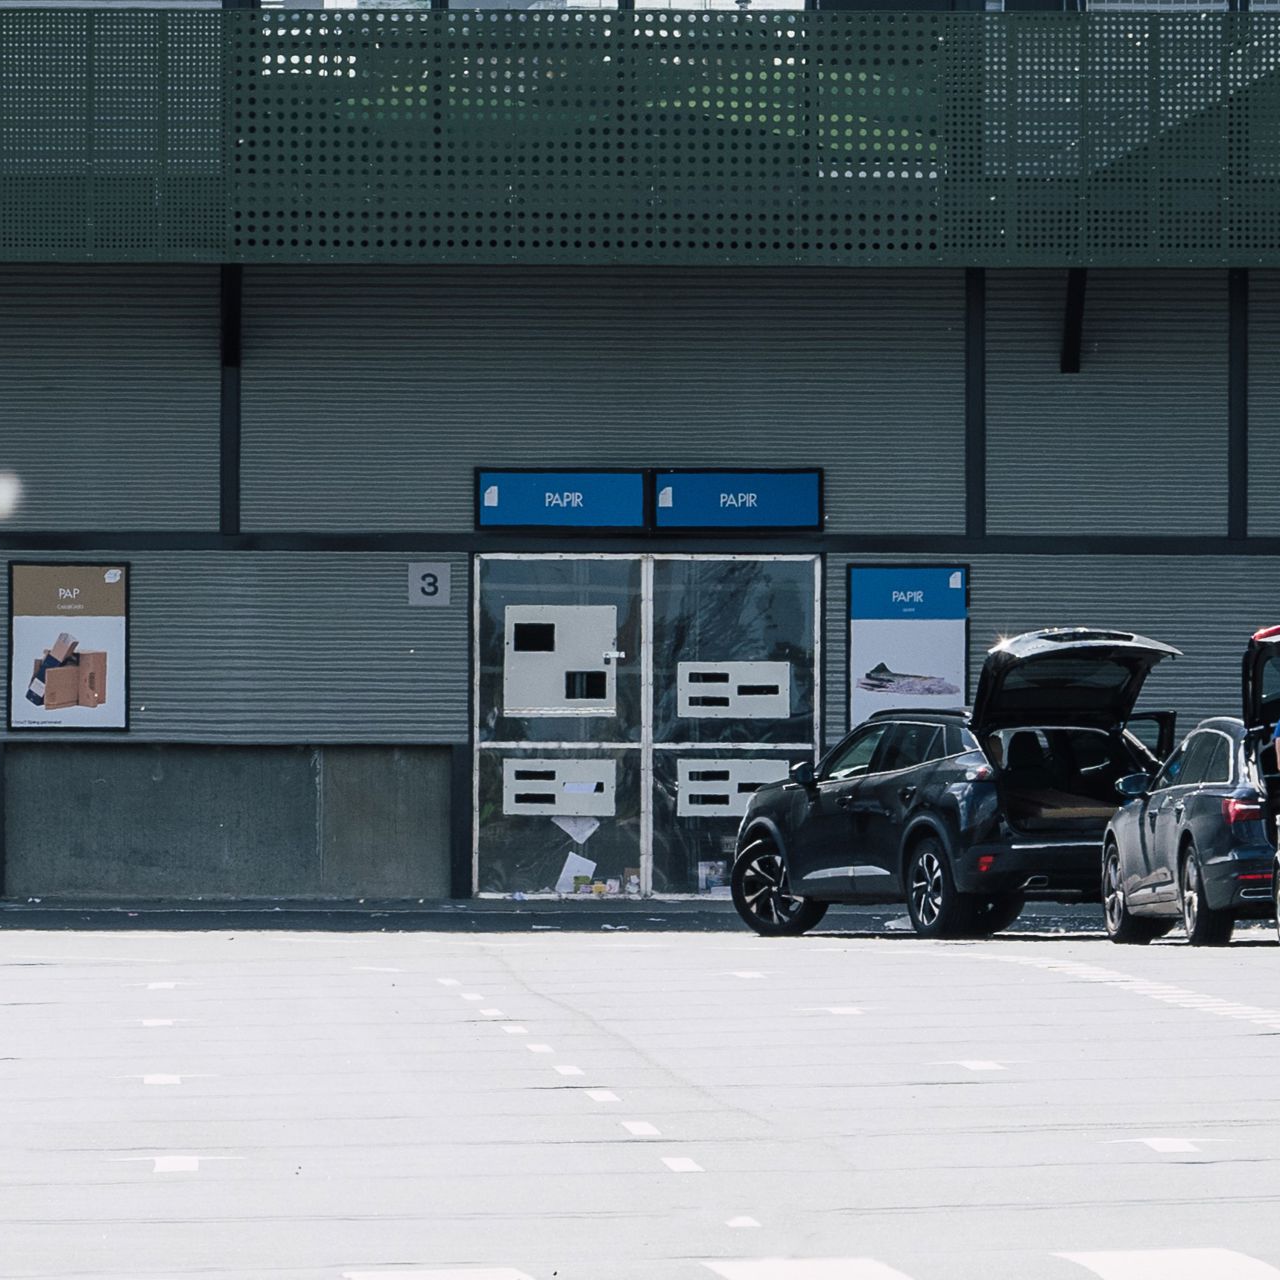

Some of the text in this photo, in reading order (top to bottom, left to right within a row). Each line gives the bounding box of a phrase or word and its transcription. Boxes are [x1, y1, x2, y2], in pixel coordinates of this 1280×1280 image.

[545, 492, 583, 507] PAPIR
[720, 493, 758, 507] PAPIR
[420, 573, 439, 596] 3
[58, 588, 80, 599] PAP
[892, 591, 924, 603] PAPIR
